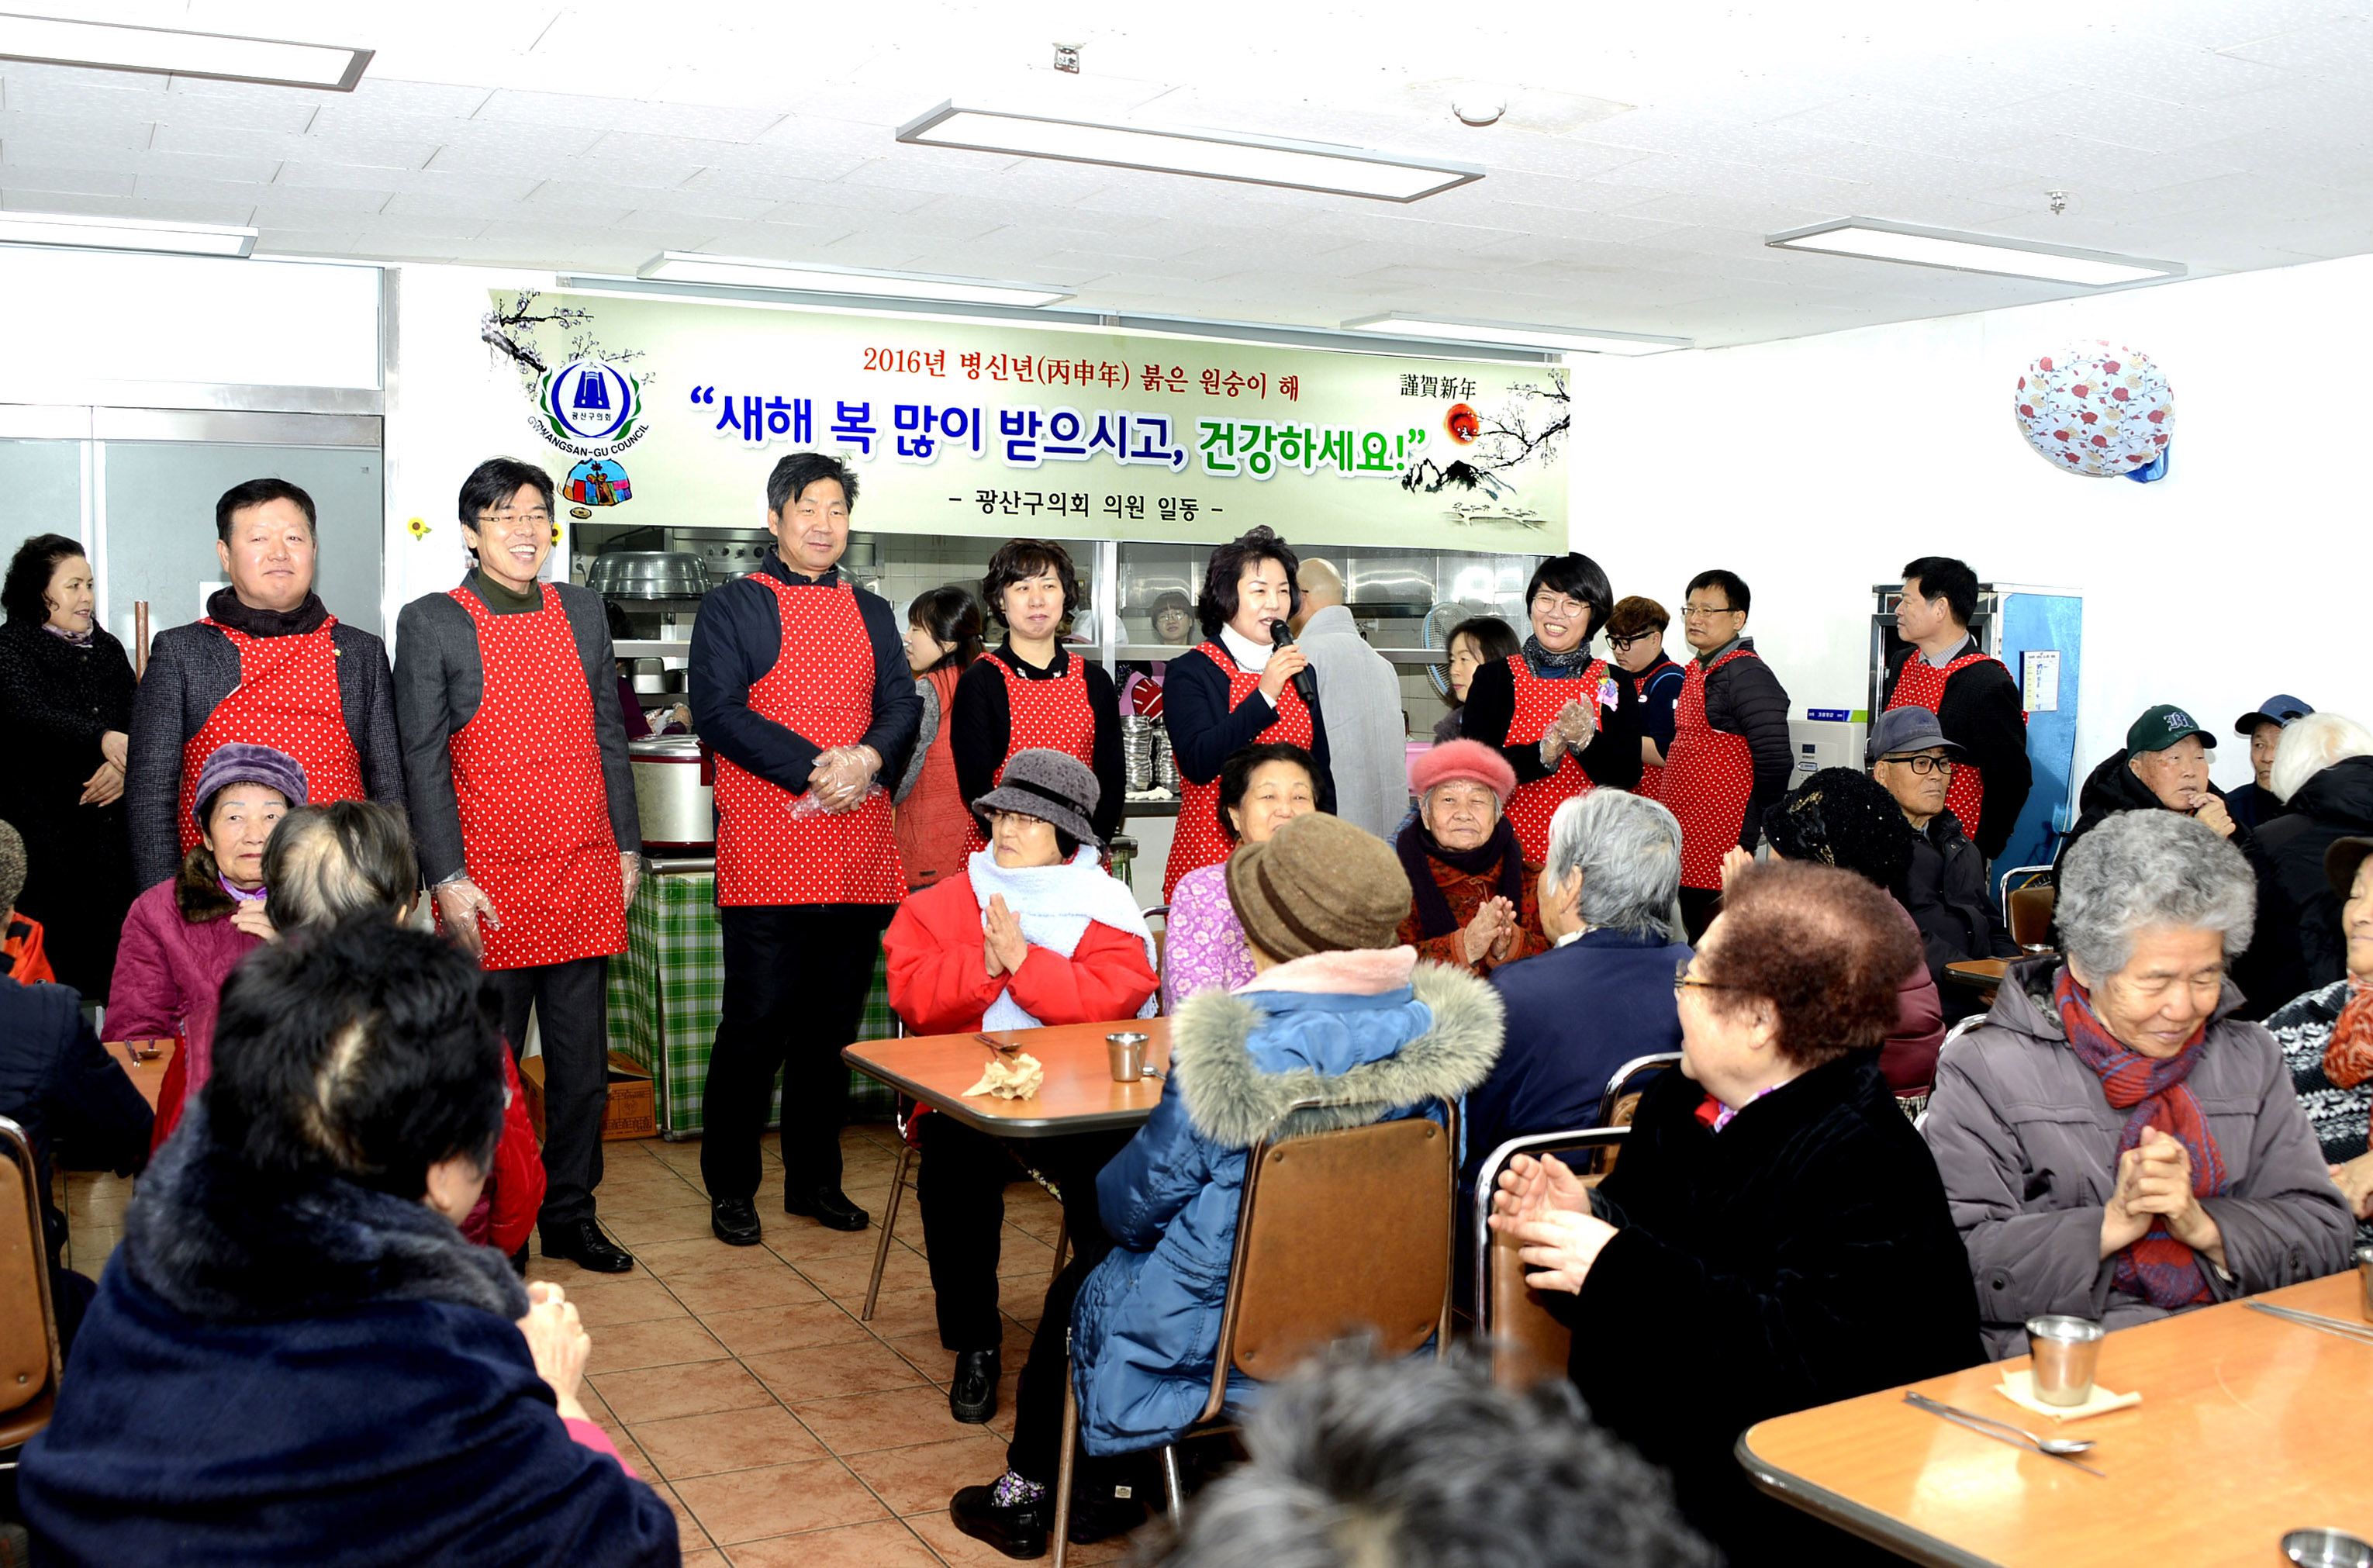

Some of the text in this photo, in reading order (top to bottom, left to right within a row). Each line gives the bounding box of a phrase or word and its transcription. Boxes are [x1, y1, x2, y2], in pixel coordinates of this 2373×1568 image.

[863, 347, 1300, 402] 2016년 병신년(丙申年) 붉은 원숭이 해
[1399, 373, 1477, 401] 謹賀新年
[572, 411, 612, 422] 광산구의회
[610, 423, 650, 454] COUNCIL
[831, 400, 877, 454] 복
[894, 404, 981, 458] 많이
[1000, 409, 1184, 466] 받으시고,
[975, 489, 1090, 518] 광산구의회
[1102, 494, 1145, 520] 의원
[1155, 496, 1200, 522] 일동
